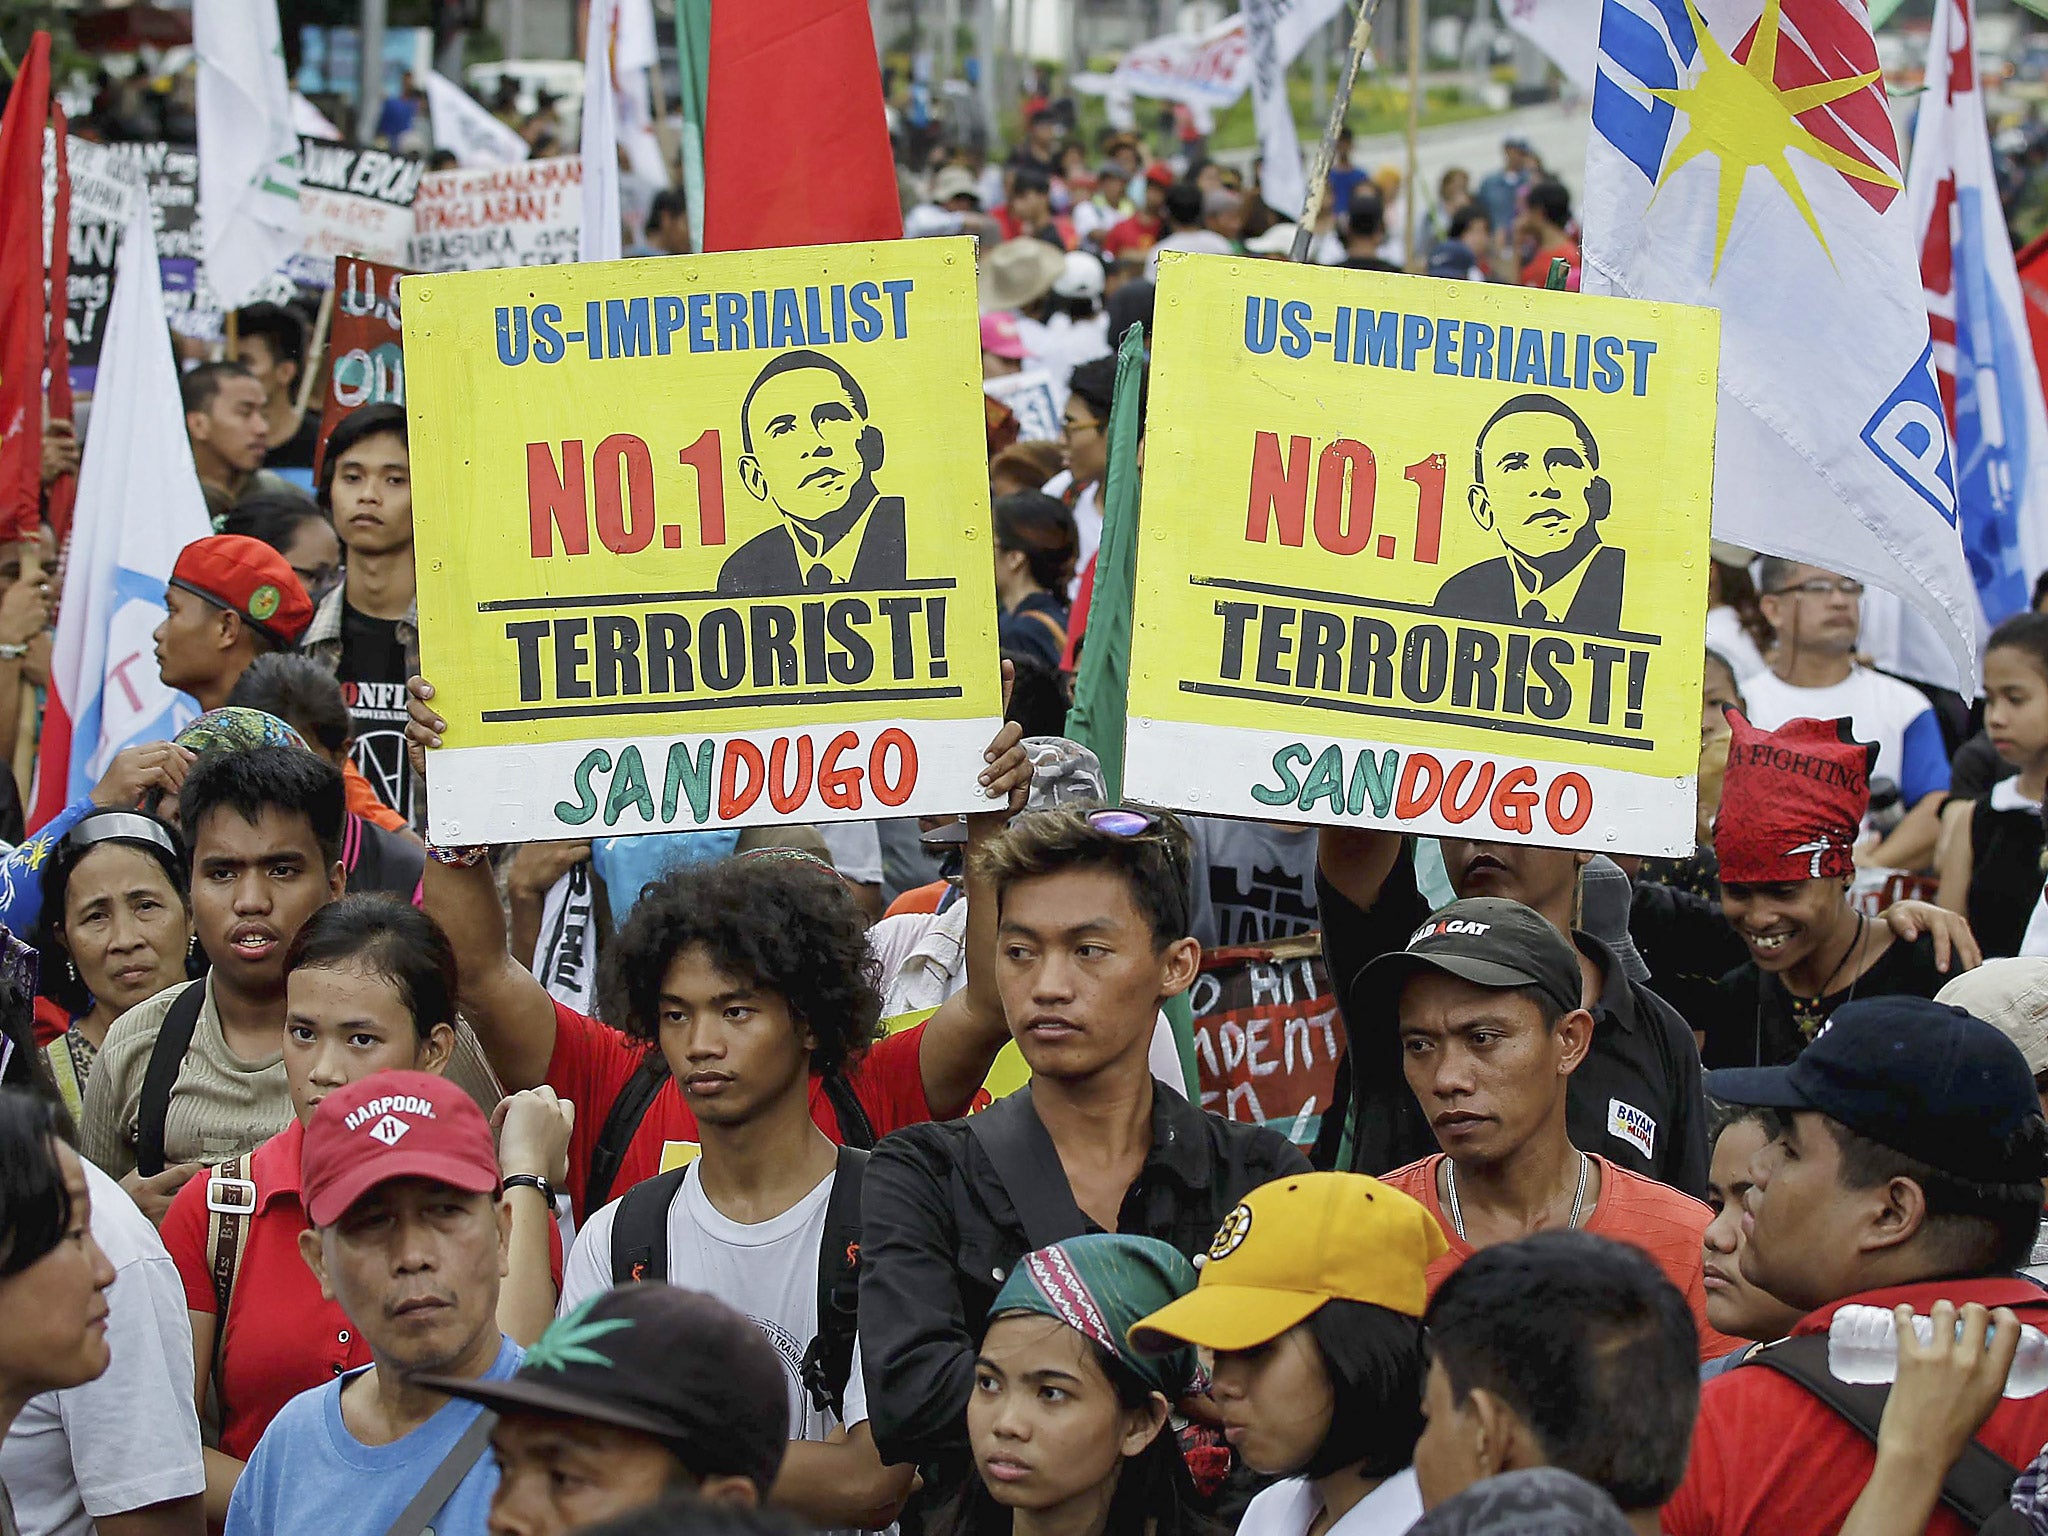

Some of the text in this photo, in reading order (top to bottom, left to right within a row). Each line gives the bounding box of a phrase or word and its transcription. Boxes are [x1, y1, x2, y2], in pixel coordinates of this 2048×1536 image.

[495, 279, 914, 367] US-IMPERIALIST
[1244, 294, 1658, 397] US-IMPERIALIST
[526, 429, 726, 559] NO.1
[1244, 430, 1448, 564] NO.1
[505, 596, 949, 702] TERRORIST!
[1213, 599, 1650, 730] TERRORIST!
[553, 727, 919, 826] SANDUGO
[1251, 742, 1593, 836] SANDUGO
[1750, 743, 1862, 796] FIGHTING
[344, 1094, 433, 1131] HARPOON
[1617, 1104, 1653, 1137] BAYAN
